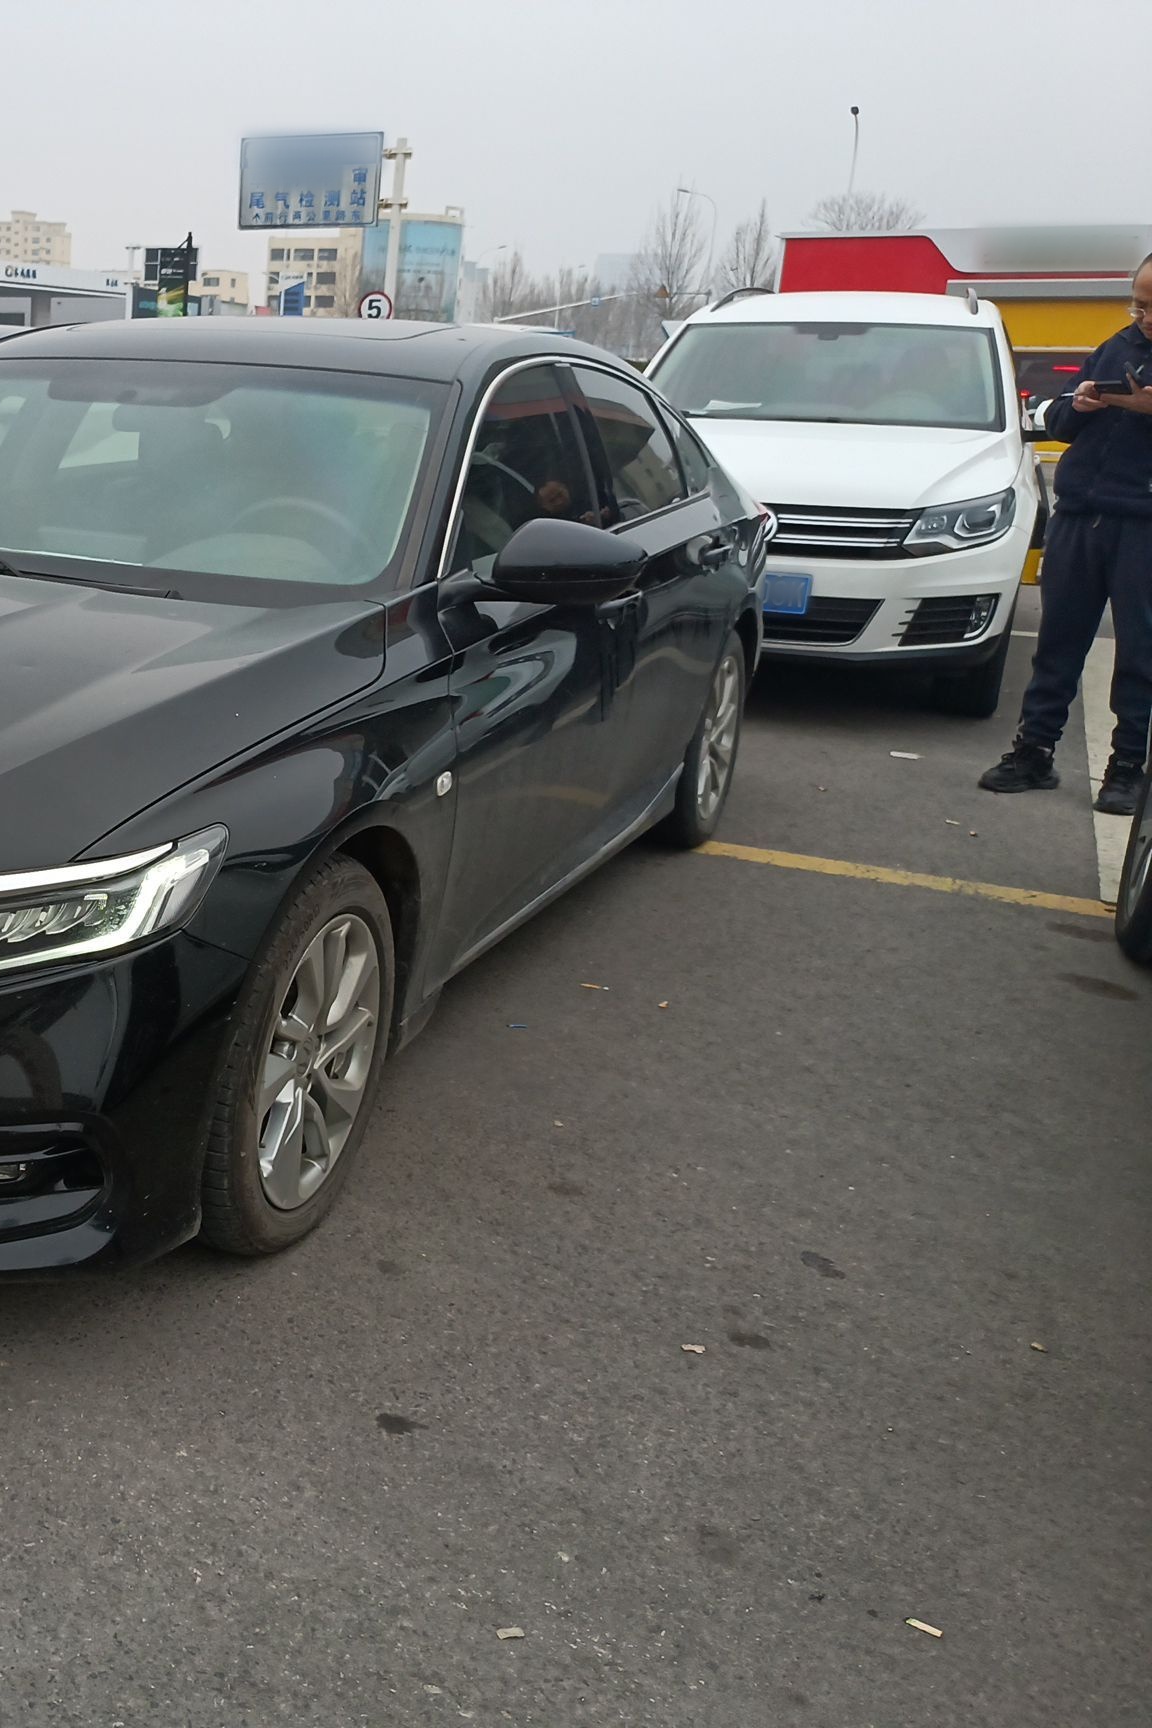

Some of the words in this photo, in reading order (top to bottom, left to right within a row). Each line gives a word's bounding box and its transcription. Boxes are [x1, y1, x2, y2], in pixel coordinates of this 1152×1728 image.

[249, 188, 367, 209] 尾气检测站
[367, 299, 381, 319] 5
